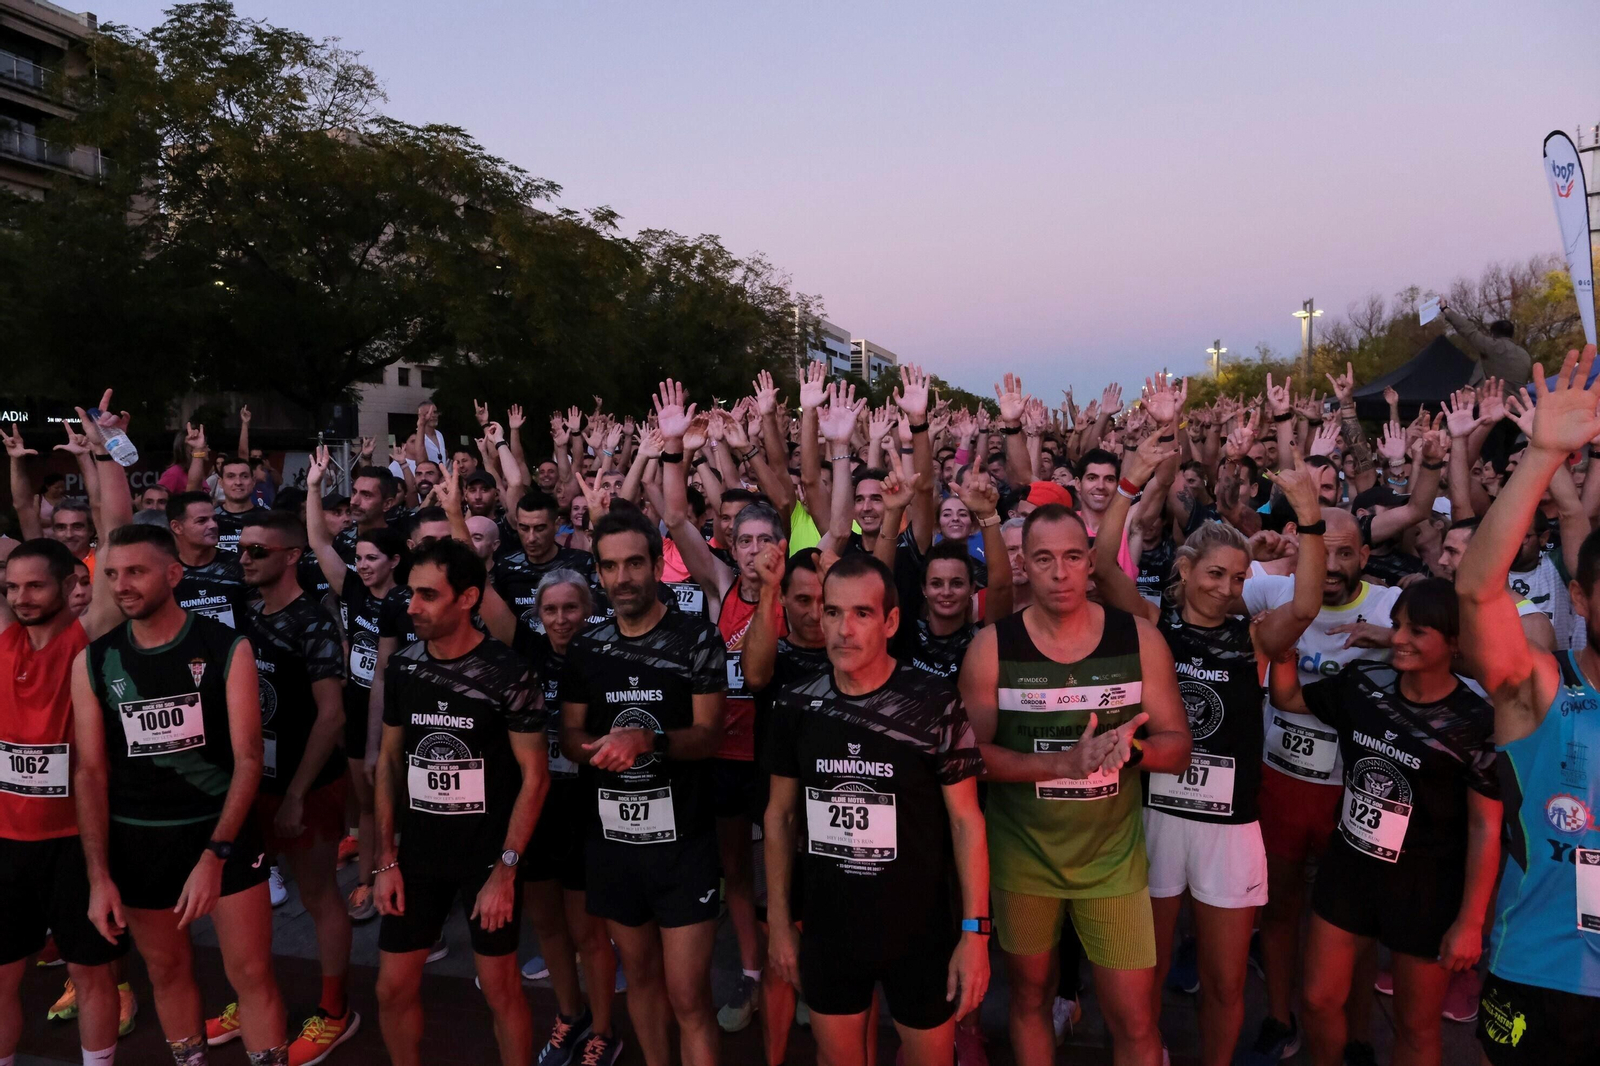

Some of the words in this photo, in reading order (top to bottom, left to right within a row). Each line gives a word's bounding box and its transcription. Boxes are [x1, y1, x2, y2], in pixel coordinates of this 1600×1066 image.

[180, 596, 227, 609] RUNMONES
[515, 597, 536, 606] RUNM
[605, 689, 664, 704] RUNMONES
[138, 708, 184, 731] 1000
[412, 713, 474, 730] RUNMONES
[1018, 724, 1072, 738] ATLETISMO
[1282, 732, 1314, 756] 623
[1352, 730, 1422, 770] RUNMONES
[9, 754, 49, 774] 1062
[816, 758, 894, 778] RUNMONES
[428, 772, 460, 790] 691
[619, 802, 650, 822] 627
[828, 804, 869, 830] 253
[1350, 798, 1382, 829] 923
